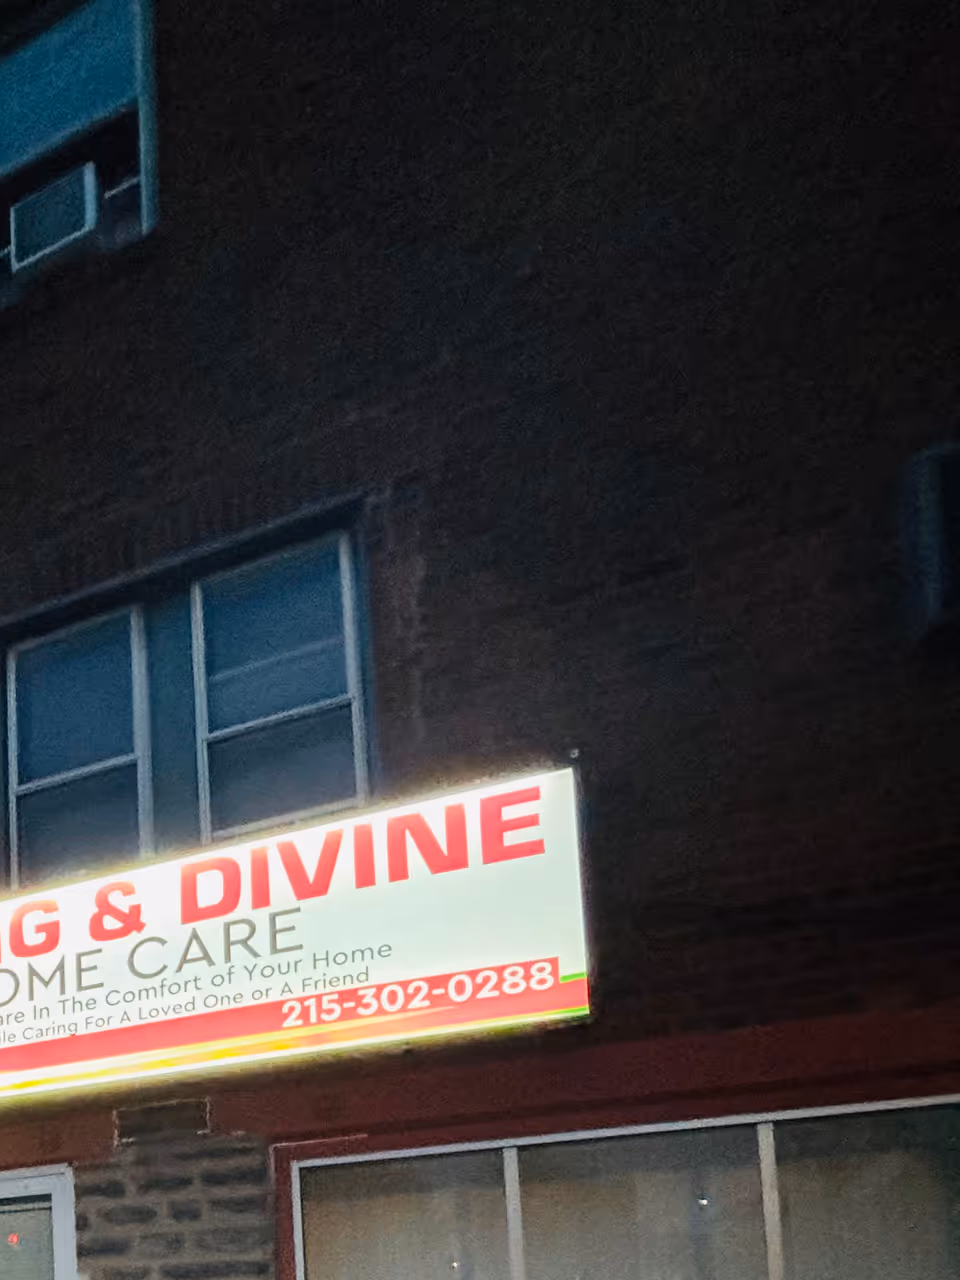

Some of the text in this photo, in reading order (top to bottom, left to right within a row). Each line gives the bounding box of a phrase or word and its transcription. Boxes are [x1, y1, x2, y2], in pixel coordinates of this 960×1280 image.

[89, 881, 146, 942] &
[180, 785, 545, 924] DIVINE
[127, 906, 304, 979] CARE
[22, 1021, 78, 1041] Caring
[85, 1014, 113, 1029] For
[119, 1010, 132, 1023] A
[138, 1000, 196, 1020] Loved
[203, 991, 243, 1009] One
[251, 986, 270, 1001] or
[280, 982, 294, 996] A
[302, 968, 370, 993] Friend
[33, 1004, 50, 1020] In
[58, 996, 97, 1015] The
[105, 974, 201, 1006] Comfort
[211, 965, 235, 988] of
[244, 958, 303, 981] Your
[313, 943, 393, 970] Home
[281, 961, 555, 1028] 215-302-0288
